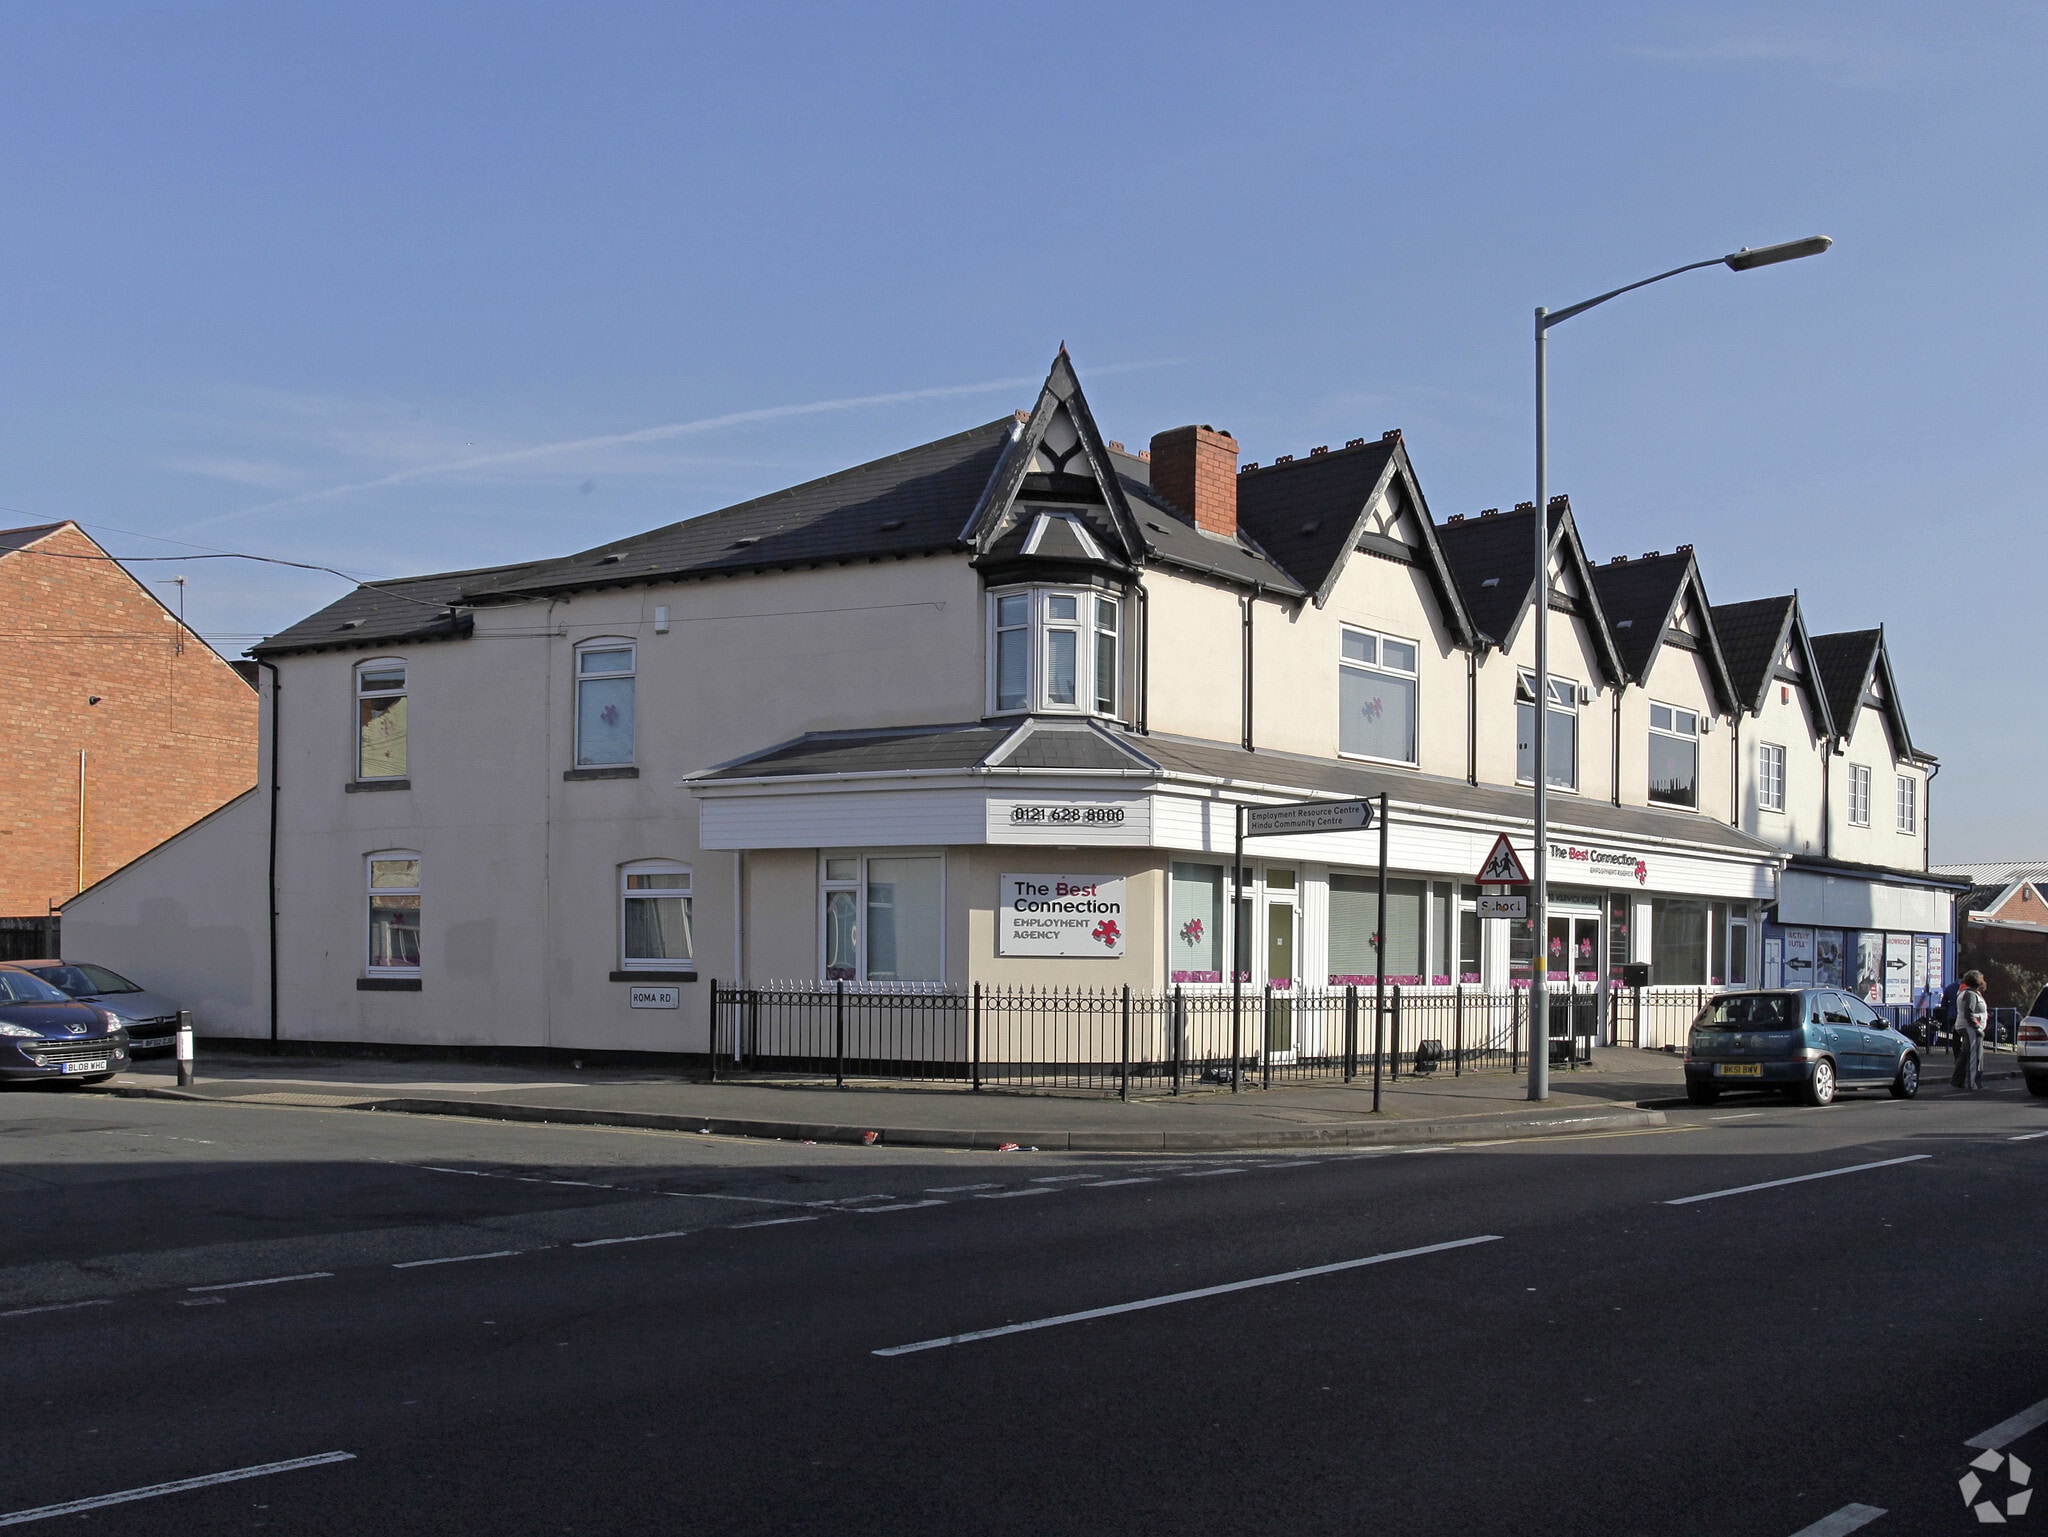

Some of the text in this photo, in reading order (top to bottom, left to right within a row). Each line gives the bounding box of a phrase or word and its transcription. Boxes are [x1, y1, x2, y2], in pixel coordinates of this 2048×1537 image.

[1014, 807, 1125, 821] 0121 628 8000
[1251, 805, 1360, 820] Employment Resource Centre
[1251, 817, 1343, 829] Hindu Community Centre
[1549, 844, 1637, 866] The Best Connection
[1014, 881, 1097, 897] The Best
[1014, 898, 1120, 914] Connection
[1013, 918, 1090, 928] EMPLOYMENT
[1013, 930, 1060, 939] AGENCY
[633, 993, 671, 1002] ROMA RD
